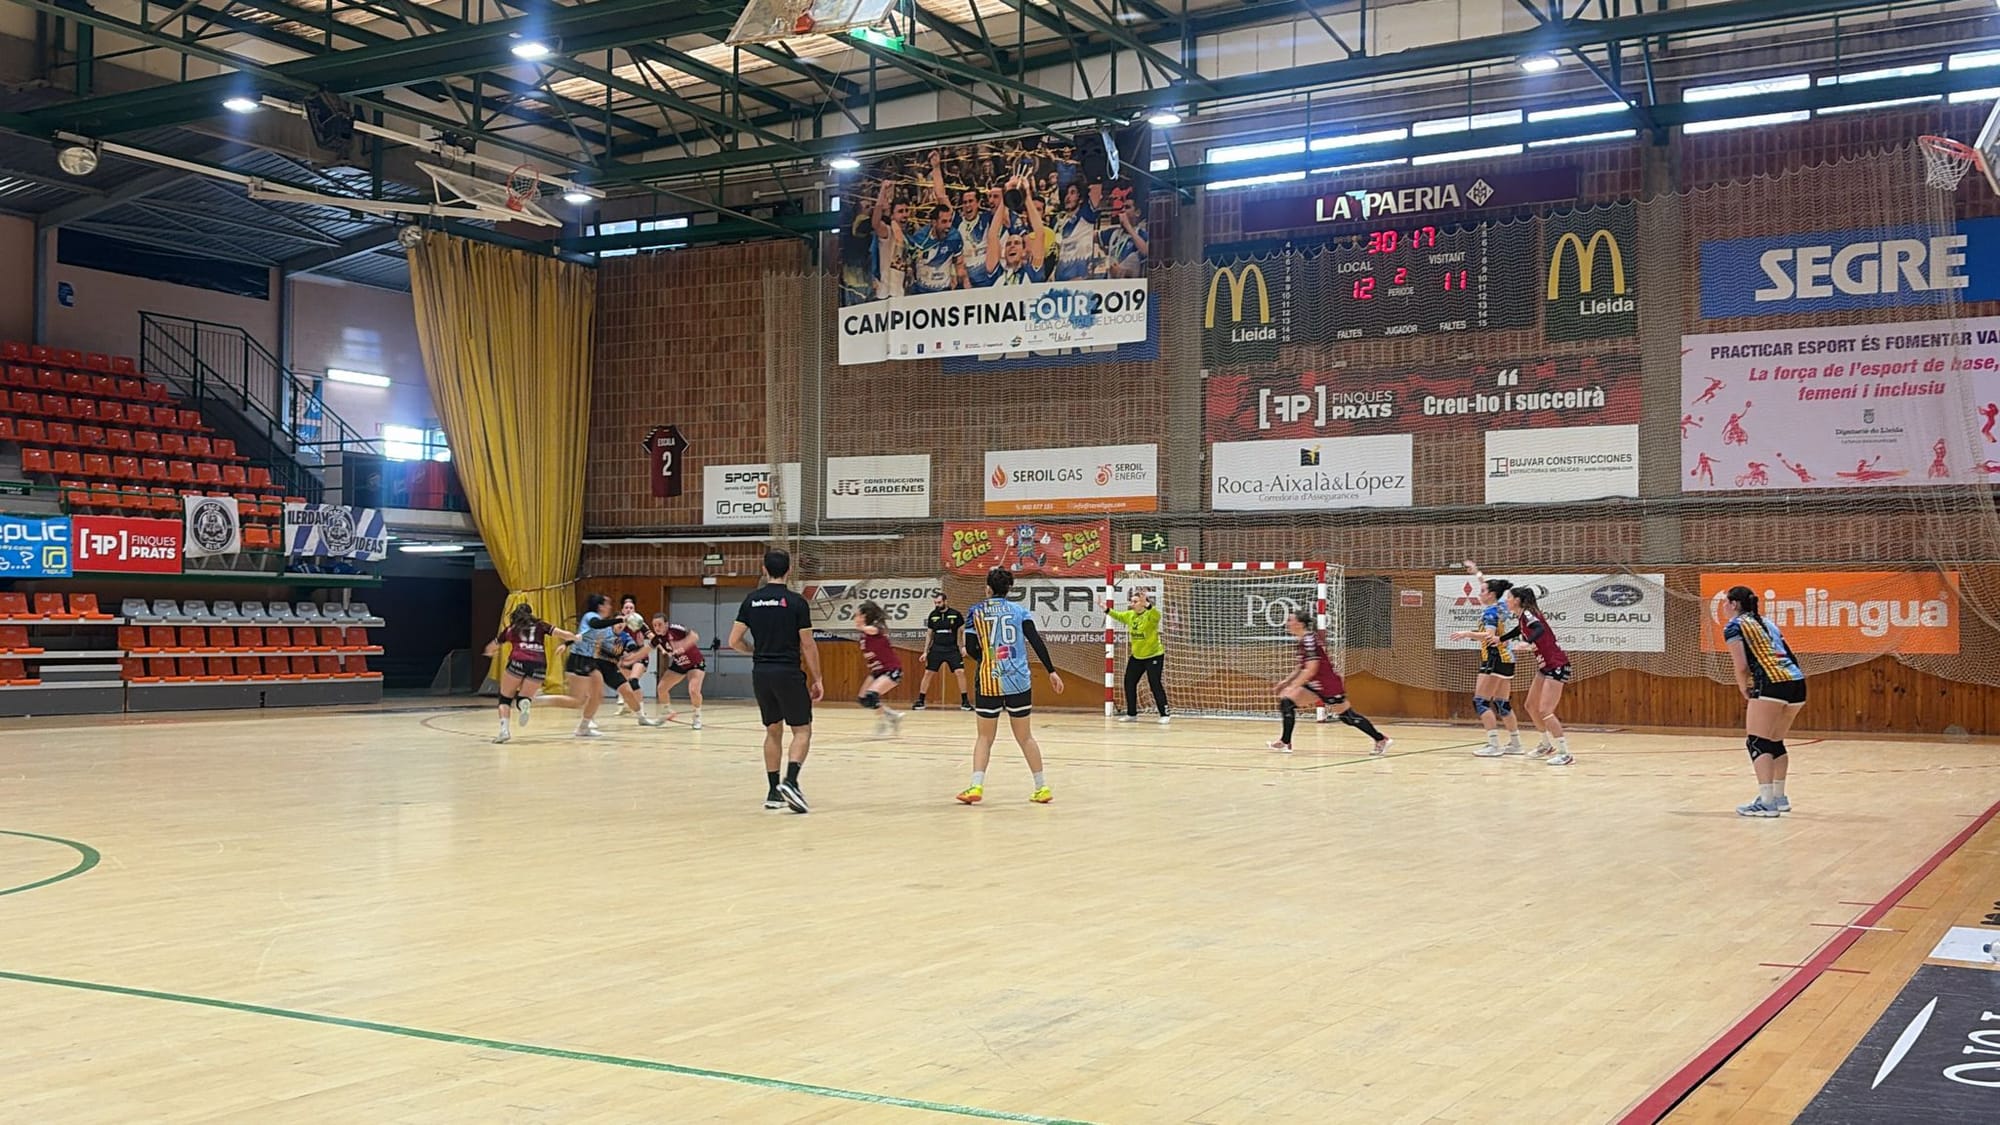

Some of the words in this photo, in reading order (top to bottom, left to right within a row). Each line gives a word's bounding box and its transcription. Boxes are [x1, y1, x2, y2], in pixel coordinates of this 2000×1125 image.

[1316, 196, 1351, 222] LA
[1365, 184, 1461, 217] PAERIA
[1368, 230, 1397, 255] 30
[1412, 226, 1436, 248] 17
[1429, 252, 1466, 264] VISITANT
[1338, 262, 1373, 273] LOCAL
[1394, 267, 1407, 284] 2
[1755, 234, 1969, 301] SEGRE
[1352, 277, 1376, 299] 12
[1444, 270, 1467, 291] 11
[844, 306, 960, 336] CAMPIONS
[1090, 289, 1146, 315] 2019
[1580, 297, 1634, 315] Lleida
[1231, 326, 1277, 342] Lleida
[1337, 329, 1363, 339] FALTES
[1384, 325, 1417, 335] JUGADOR
[1440, 320, 1466, 330] FALTES
[1711, 342, 1793, 360] PRACTICAR
[1798, 339, 1857, 355] ESPORT
[1861, 335, 1880, 351] ÉS
[1886, 331, 1972, 350] FOMENTAR
[1976, 330, 2000, 345] VA
[1749, 368, 1768, 381] La
[1774, 366, 1817, 383] força
[1823, 364, 1844, 377] de
[1849, 359, 1918, 378] l'esport
[1923, 358, 1945, 373] de
[1332, 391, 1393, 405] FINQUES
[1798, 383, 1857, 401] femení
[1862, 382, 1869, 398] i
[1874, 380, 1946, 397] inclusiu
[1423, 393, 1500, 415] Creu-ho
[1504, 392, 1511, 411] i
[1515, 386, 1605, 411] succeirà
[1332, 403, 1393, 420] PRATS
[662, 451, 672, 476] 2
[1115, 463, 1143, 472] SEROIL
[1510, 458, 1544, 467] BUJVAR
[1546, 453, 1632, 466] CONSTRUCCIONES
[725, 472, 771, 483] SPORT
[1013, 469, 1055, 482] SEROIL
[1057, 468, 1083, 482] GAS
[1115, 472, 1146, 481] ENERGY
[1217, 470, 1406, 495] Roca-Aixalà&López
[131, 535, 176, 547] FINQUES
[953, 529, 989, 550] Peta
[1062, 529, 1098, 550] Peta
[131, 547, 176, 560] PRATS
[952, 541, 992, 567] Zetas
[1062, 540, 1101, 567] Zetas
[845, 584, 941, 600] Ascensors
[1583, 612, 1651, 623] SUBARU
[1763, 587, 1949, 638] inlingua
[983, 613, 1018, 645] 76
